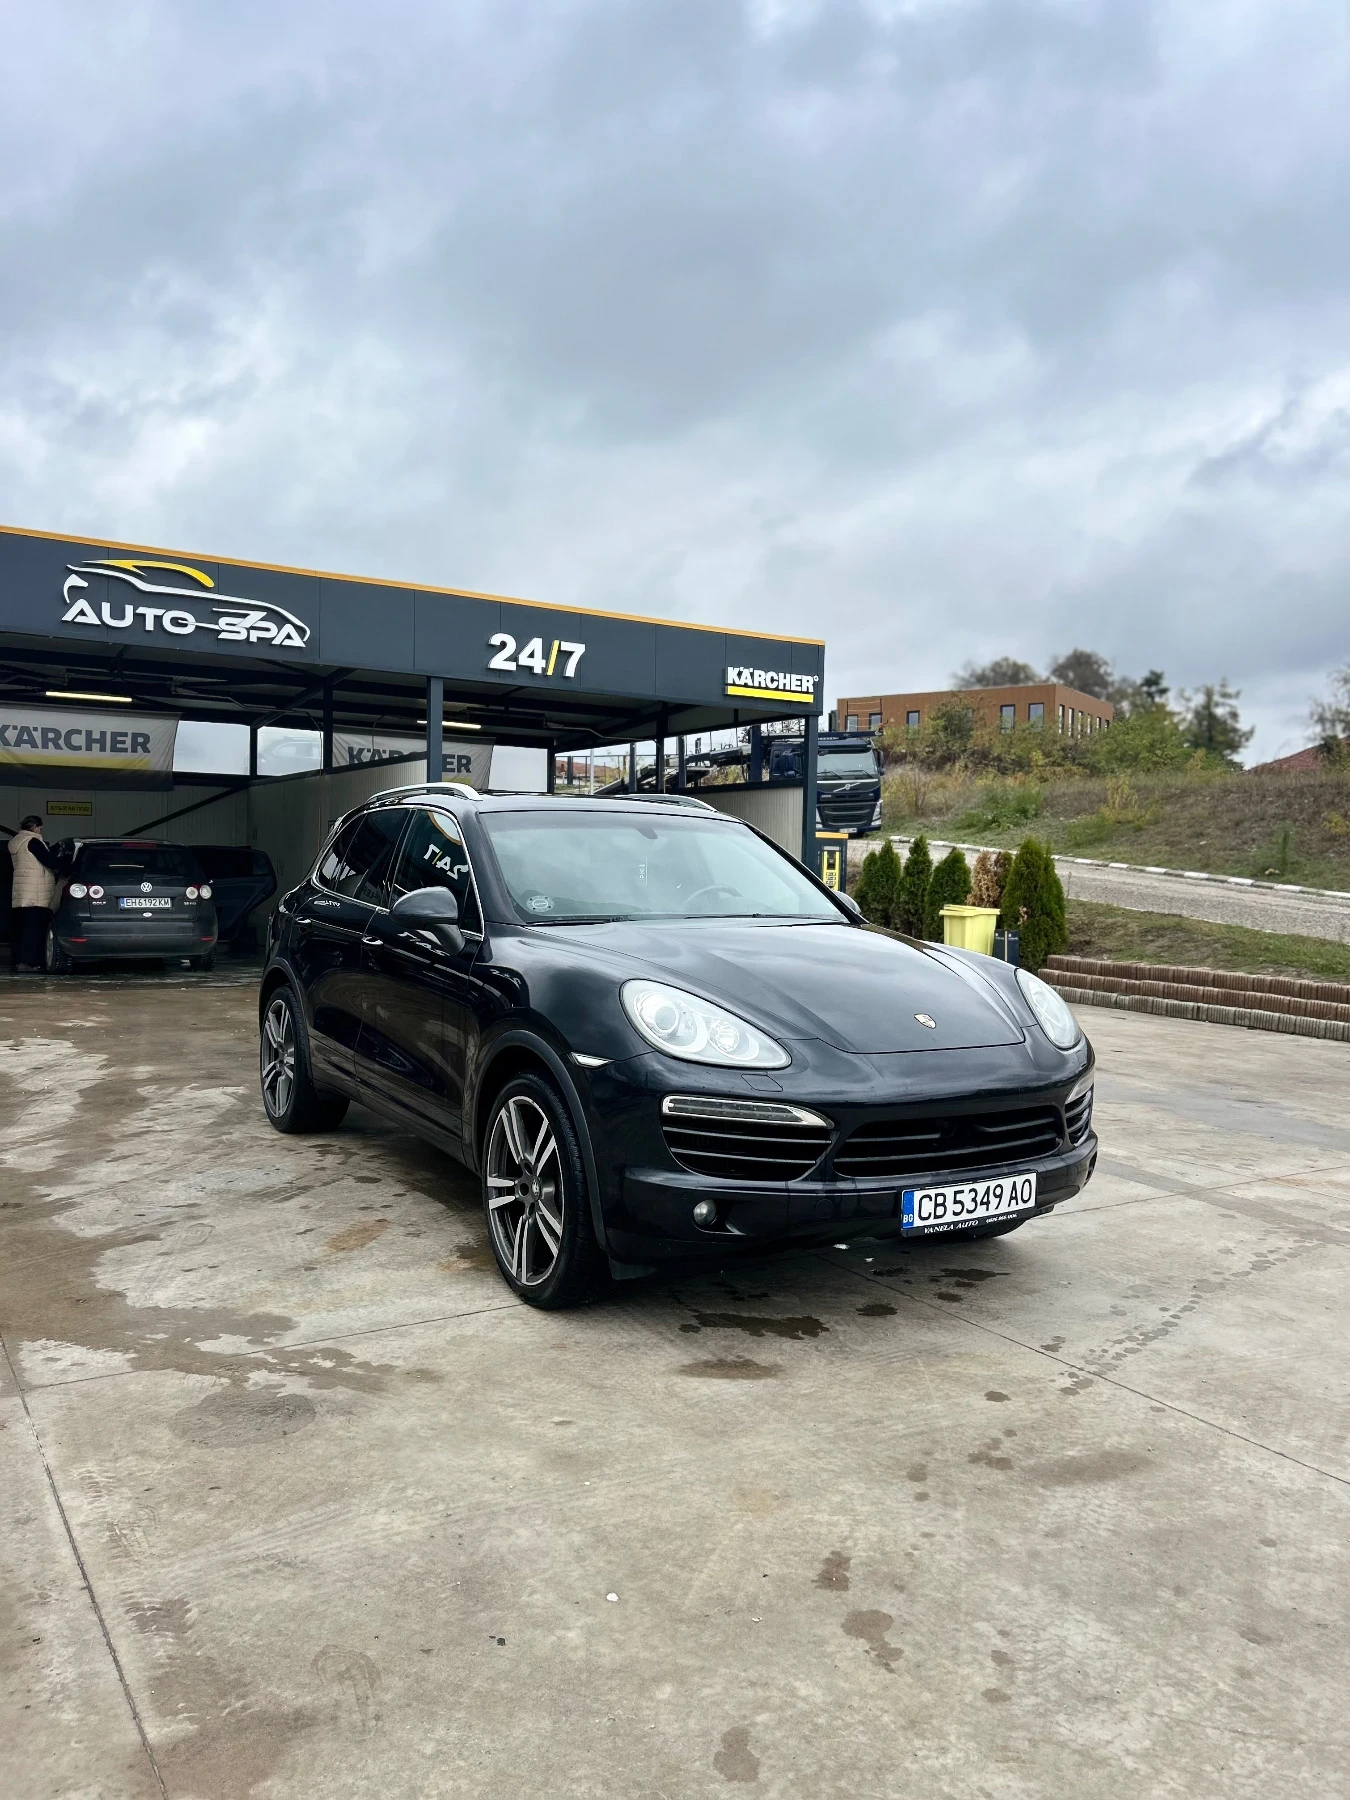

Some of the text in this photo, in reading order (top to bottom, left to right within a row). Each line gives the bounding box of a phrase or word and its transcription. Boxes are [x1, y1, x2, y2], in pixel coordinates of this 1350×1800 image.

[62, 599, 306, 648] AUTO SPA
[488, 632, 586, 678] 24/7
[727, 666, 814, 692] KÄRCHER
[903, 1214, 914, 1223] BG
[955, 1219, 979, 1229] AUTO
